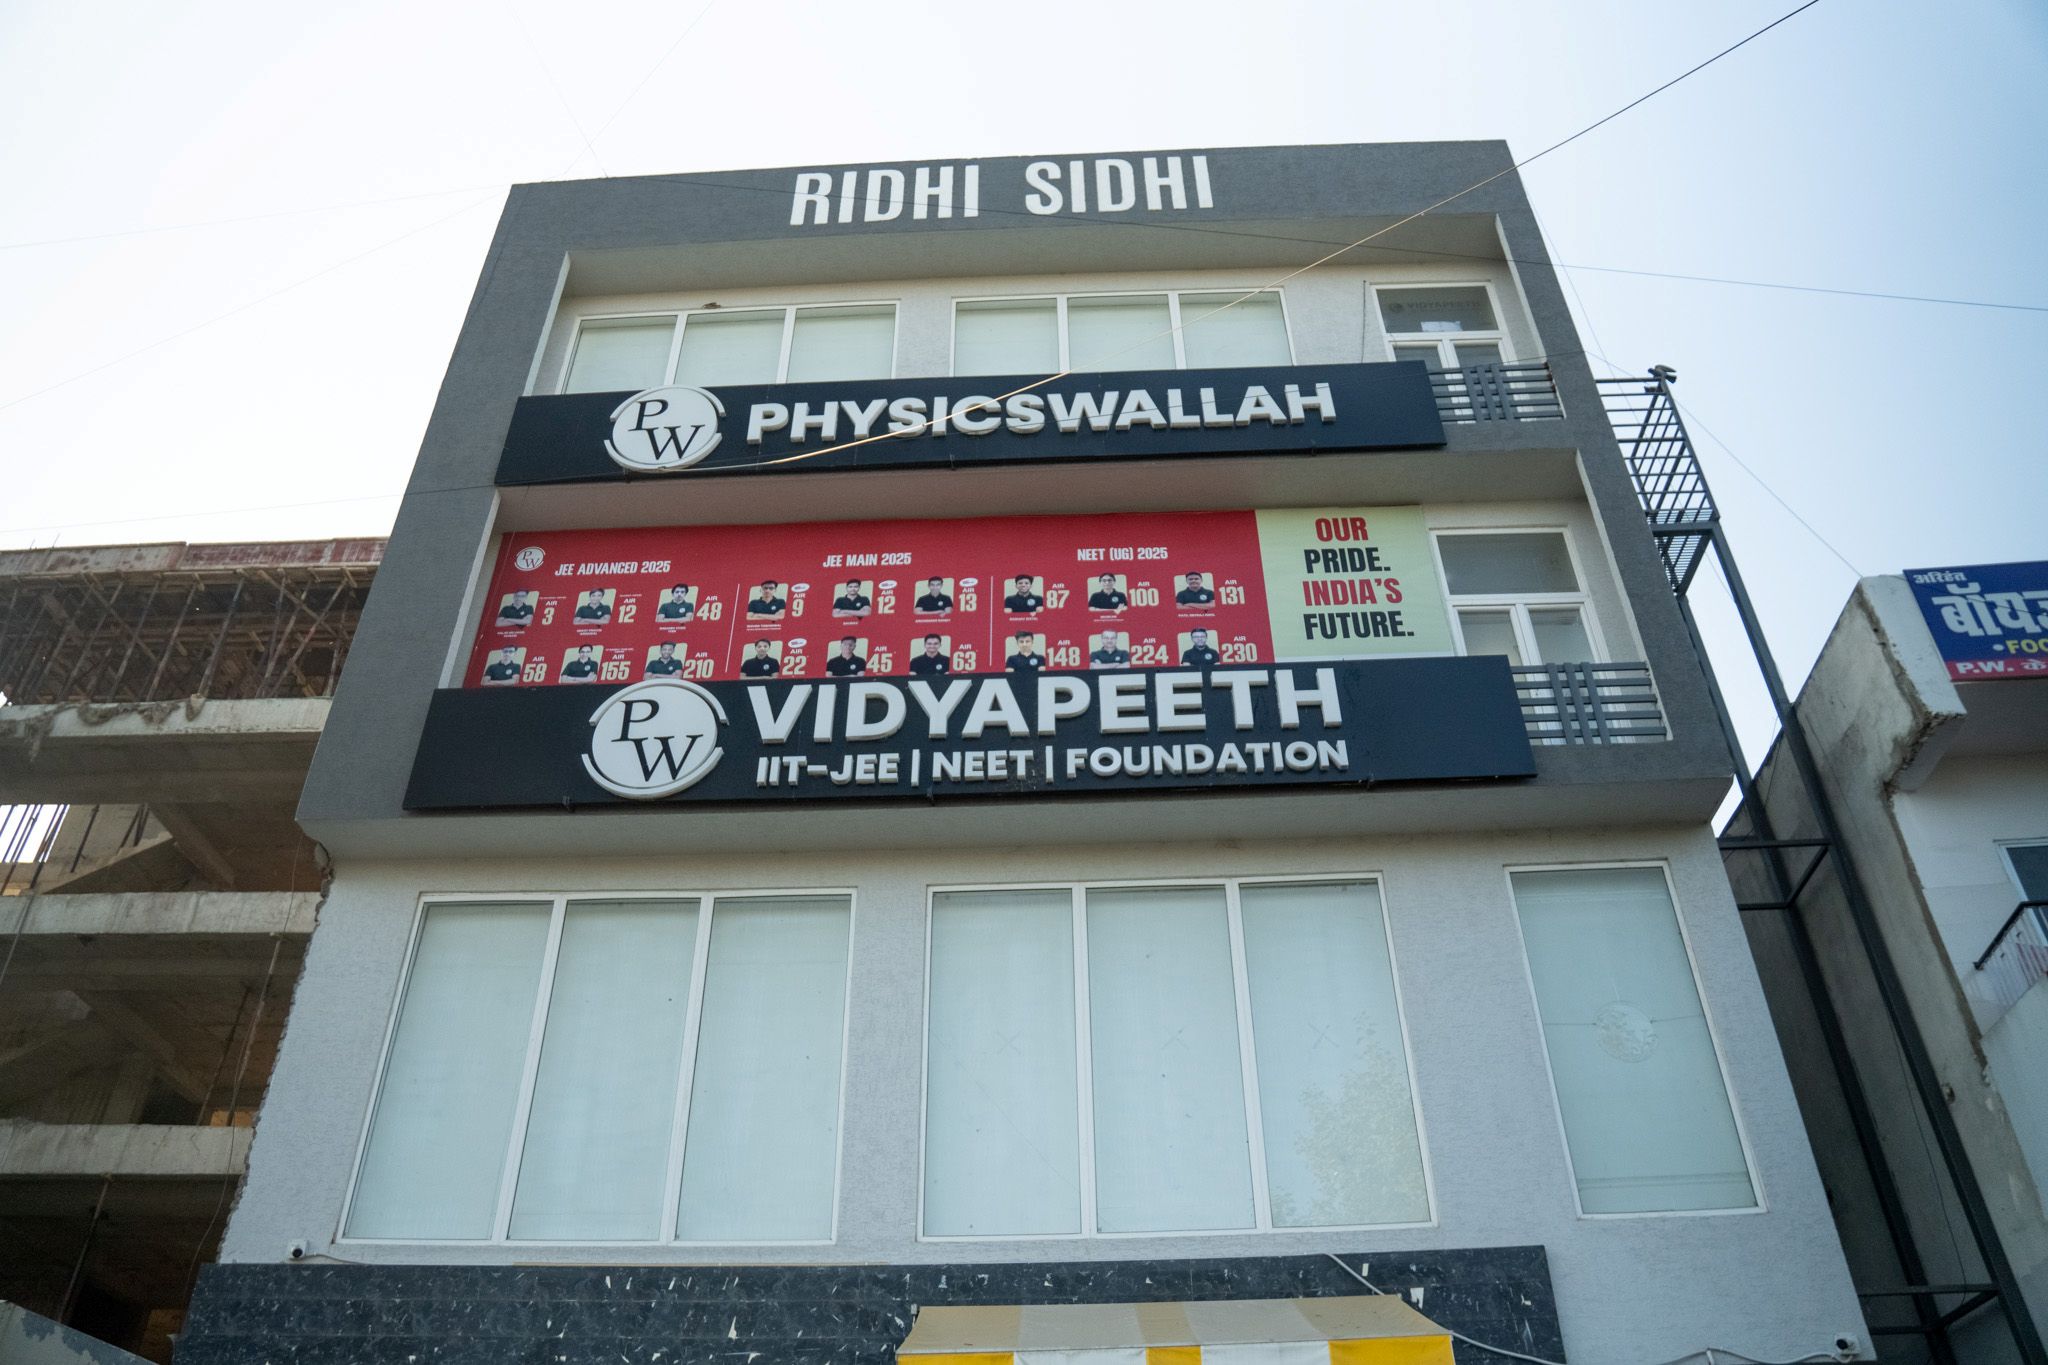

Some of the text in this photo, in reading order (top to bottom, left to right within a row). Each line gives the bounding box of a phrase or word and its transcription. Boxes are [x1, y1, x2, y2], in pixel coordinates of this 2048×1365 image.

[790, 156, 1213, 225] RIDHI SIDHI
[746, 382, 1336, 445] PHYSICSWALLAH
[1315, 517, 1368, 542] OUR
[822, 552, 912, 568] JEE MAIN 2025
[1077, 547, 1168, 561] NEET (UG) 2025
[1304, 547, 1391, 573] PRIDE.
[555, 560, 671, 576] JEE ADVANCED 2025
[1913, 571, 1967, 584] अरिहंत
[1046, 590, 1070, 609] 87
[1129, 588, 1160, 607] 100
[1219, 586, 1245, 605] 131
[1302, 578, 1403, 606] INDIA'S
[696, 602, 723, 621] 48
[792, 599, 804, 617] 9
[877, 596, 896, 614] 12
[959, 593, 977, 612] 13
[542, 607, 555, 625] 3
[618, 605, 637, 623] 12
[1303, 611, 1415, 640] FUTURE.
[953, 651, 977, 671] 63
[1047, 646, 1080, 667] 148
[1130, 645, 1169, 665] 224
[1221, 643, 1258, 662] 230
[522, 663, 548, 682] 58
[600, 661, 631, 681] 155
[683, 659, 715, 679] 210
[782, 655, 807, 675] 22
[866, 653, 893, 673] 45
[1956, 660, 2015, 674] P.W.
[747, 667, 1342, 744] VIDYAPEETH
[756, 753, 900, 787] IIT-JEE
[932, 749, 1034, 782] NEET
[1066, 740, 1349, 779] FOUNDATION
